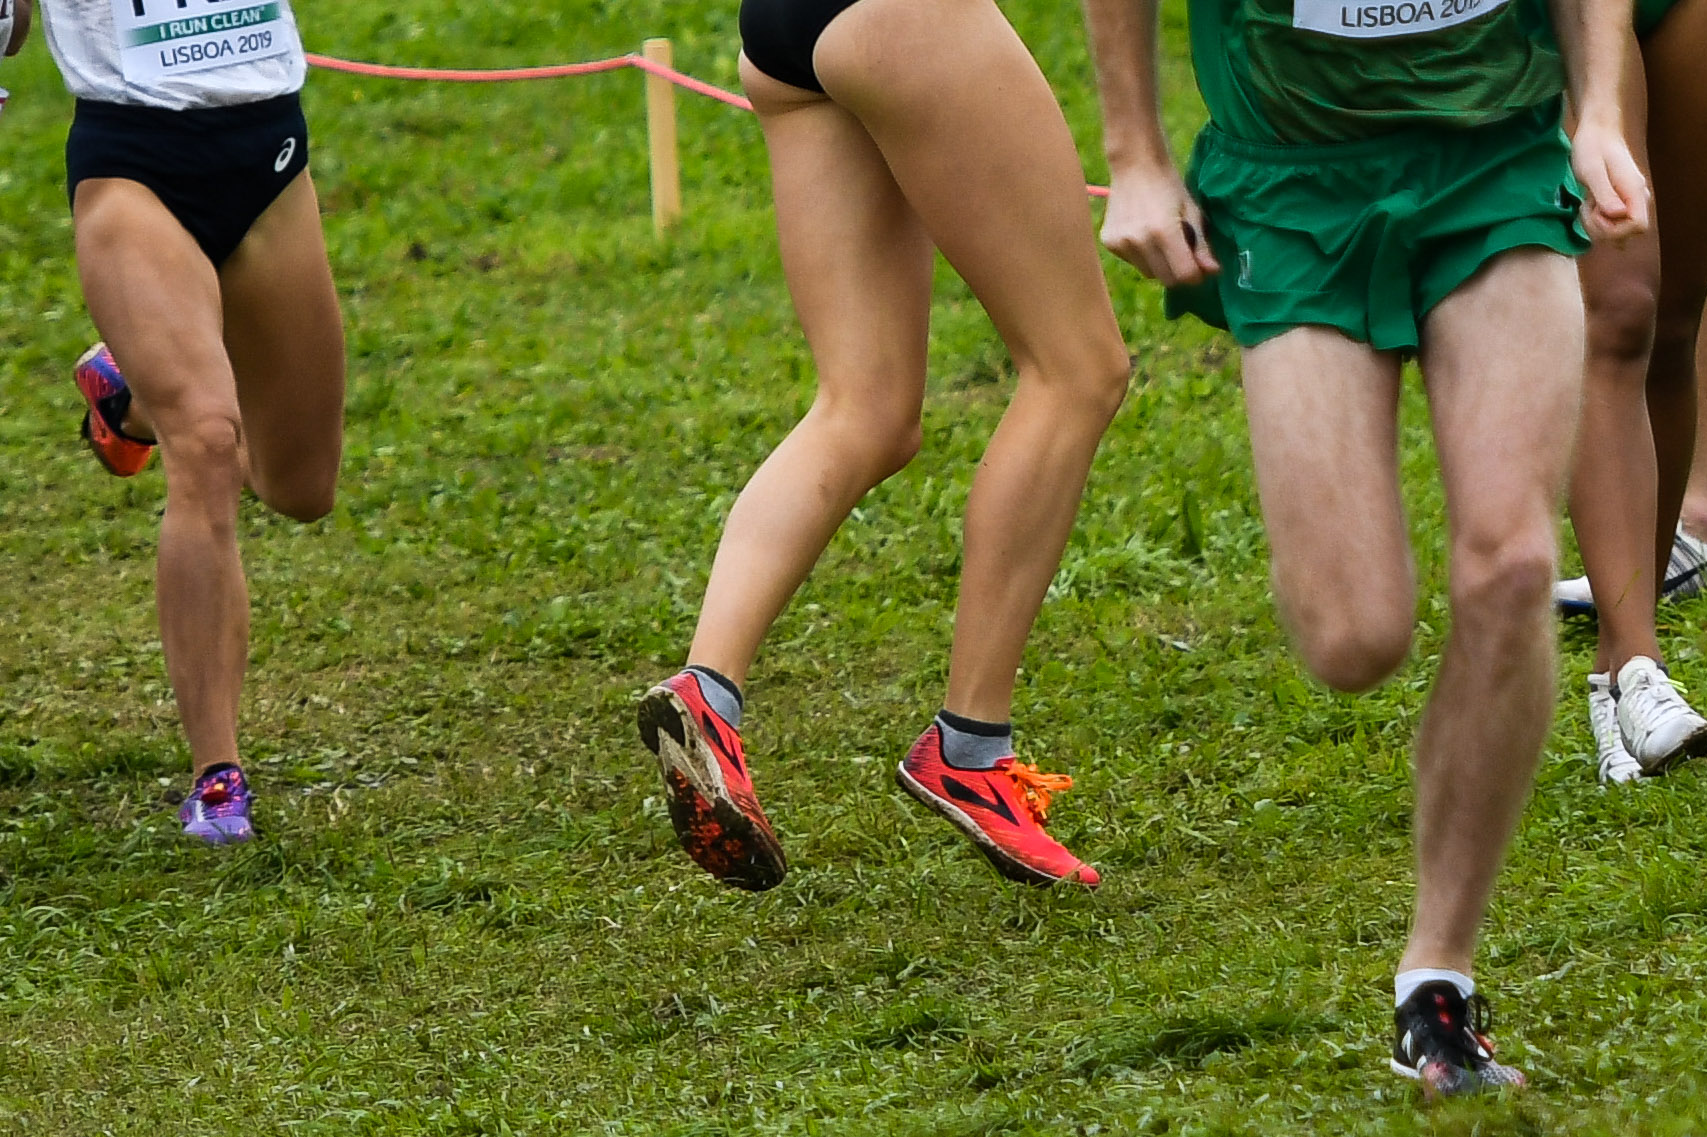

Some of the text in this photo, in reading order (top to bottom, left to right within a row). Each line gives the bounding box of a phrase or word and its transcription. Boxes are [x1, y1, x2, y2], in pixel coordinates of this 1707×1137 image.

[160, 10, 261, 39] I RUN CLEAN
[1341, 0, 1435, 28] LISBOA
[160, 31, 273, 67] LISBOA 2019
